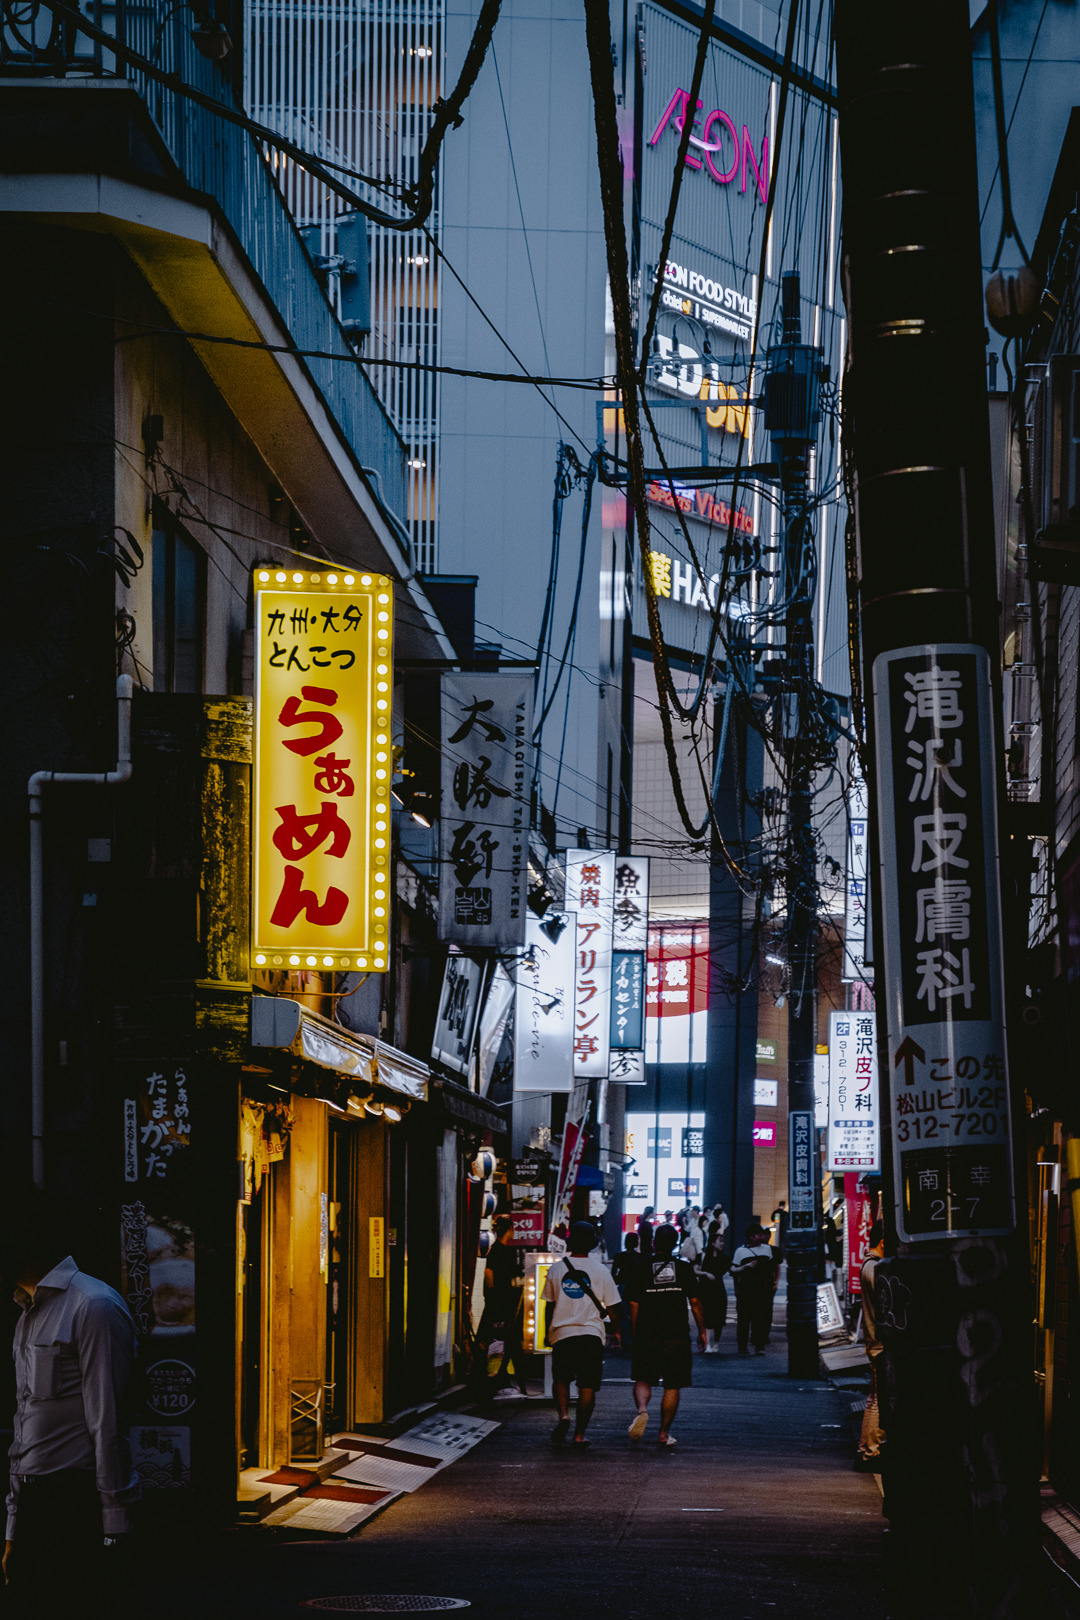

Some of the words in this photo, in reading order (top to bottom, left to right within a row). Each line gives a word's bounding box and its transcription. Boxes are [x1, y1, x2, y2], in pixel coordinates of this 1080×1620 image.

[689, 270, 724, 303] FOOD
[269, 641, 356, 672] とんこつ
[269, 685, 355, 929] らぁめん
[904, 664, 976, 1012] 滝沢皮膚科
[574, 922, 602, 1063] アリラン亭
[615, 957, 631, 1045] イカセンター
[837, 1024, 850, 1035] 2F
[855, 1017, 874, 1112] 滝沢皮フ科
[929, 1054, 1005, 1081] この先
[140, 1071, 175, 1178] たまがった
[174, 1067, 191, 1135] らぁめん
[897, 1112, 1009, 1142] 312-7201
[151, 1393, 189, 1408] ¥120
